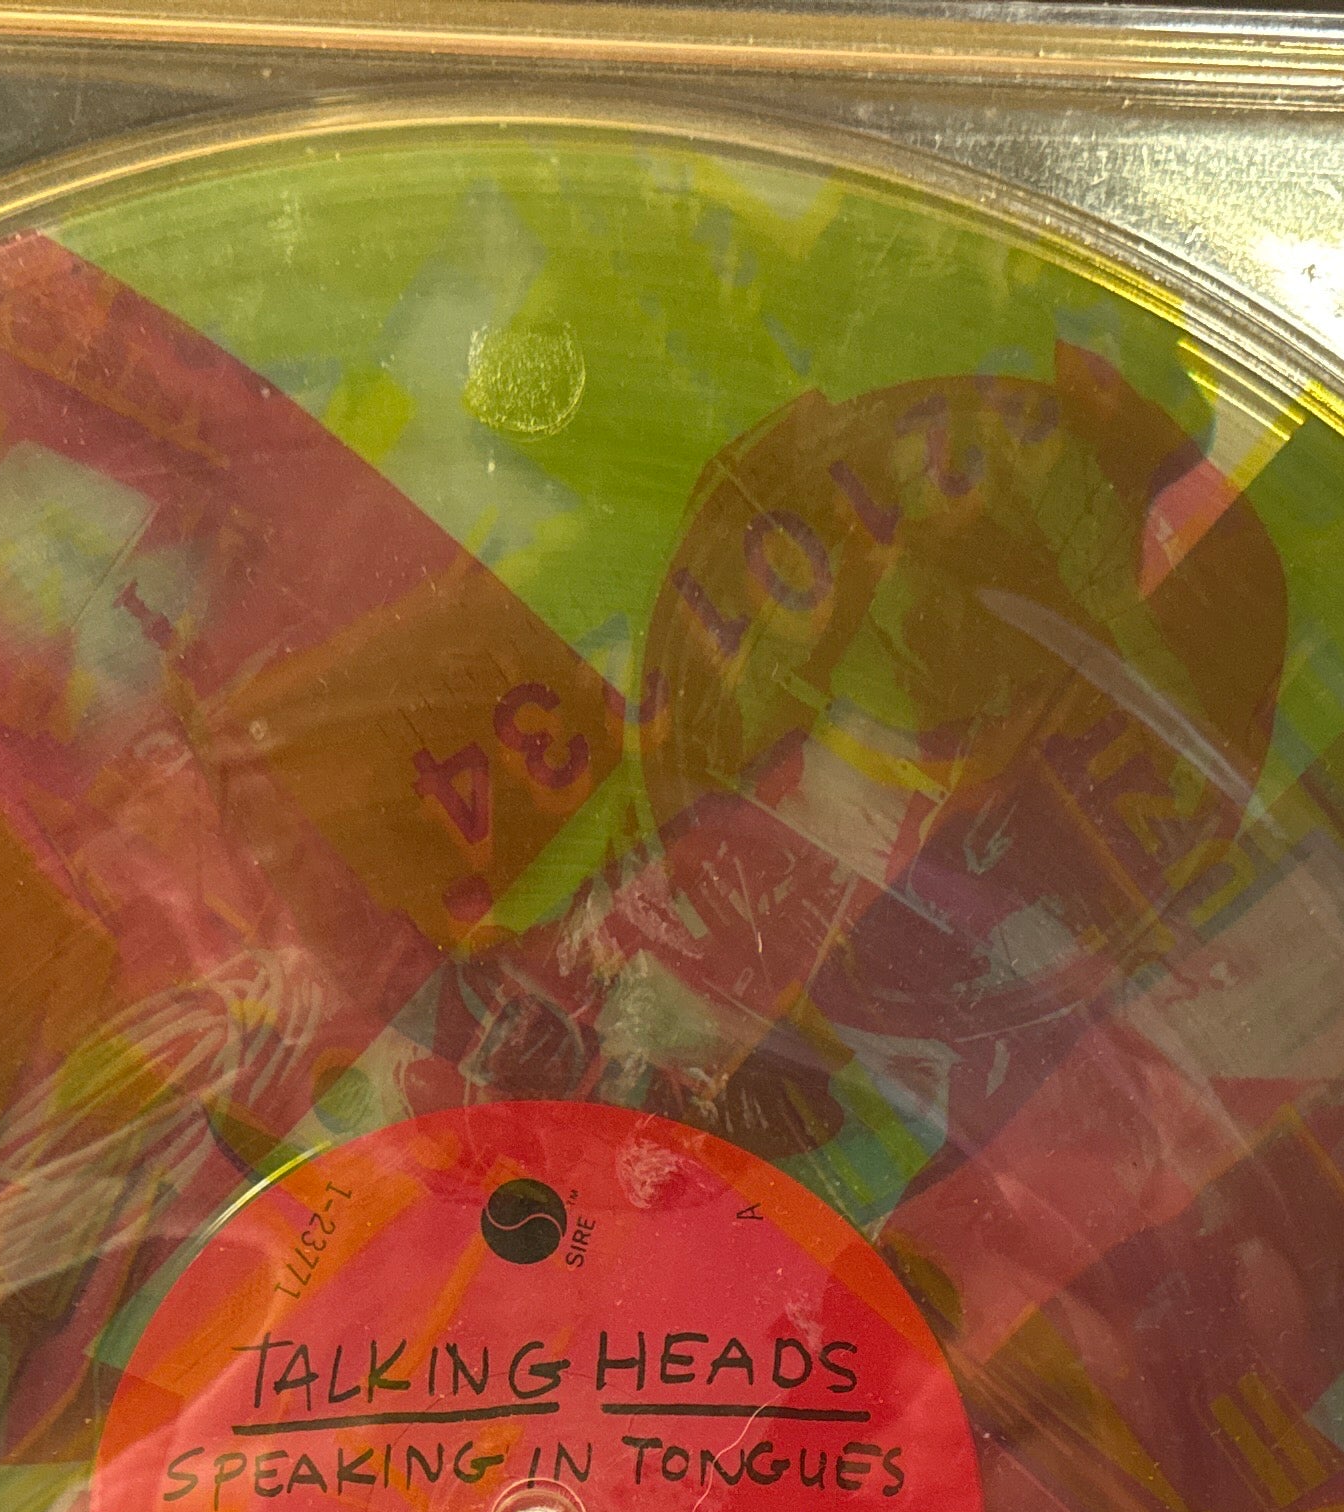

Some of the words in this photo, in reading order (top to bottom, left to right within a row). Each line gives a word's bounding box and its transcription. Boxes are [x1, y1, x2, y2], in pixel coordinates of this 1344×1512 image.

[274, 1182, 353, 1300] 1-23771
[565, 1216, 596, 1268] SIRE
[736, 1203, 764, 1220] A
[233, 1332, 570, 1412] TALKING
[596, 1330, 858, 1392] HEADS
[162, 1440, 504, 1511] SPEAKING
[527, 1442, 593, 1488] IN
[622, 1436, 905, 1498] TONGUES
